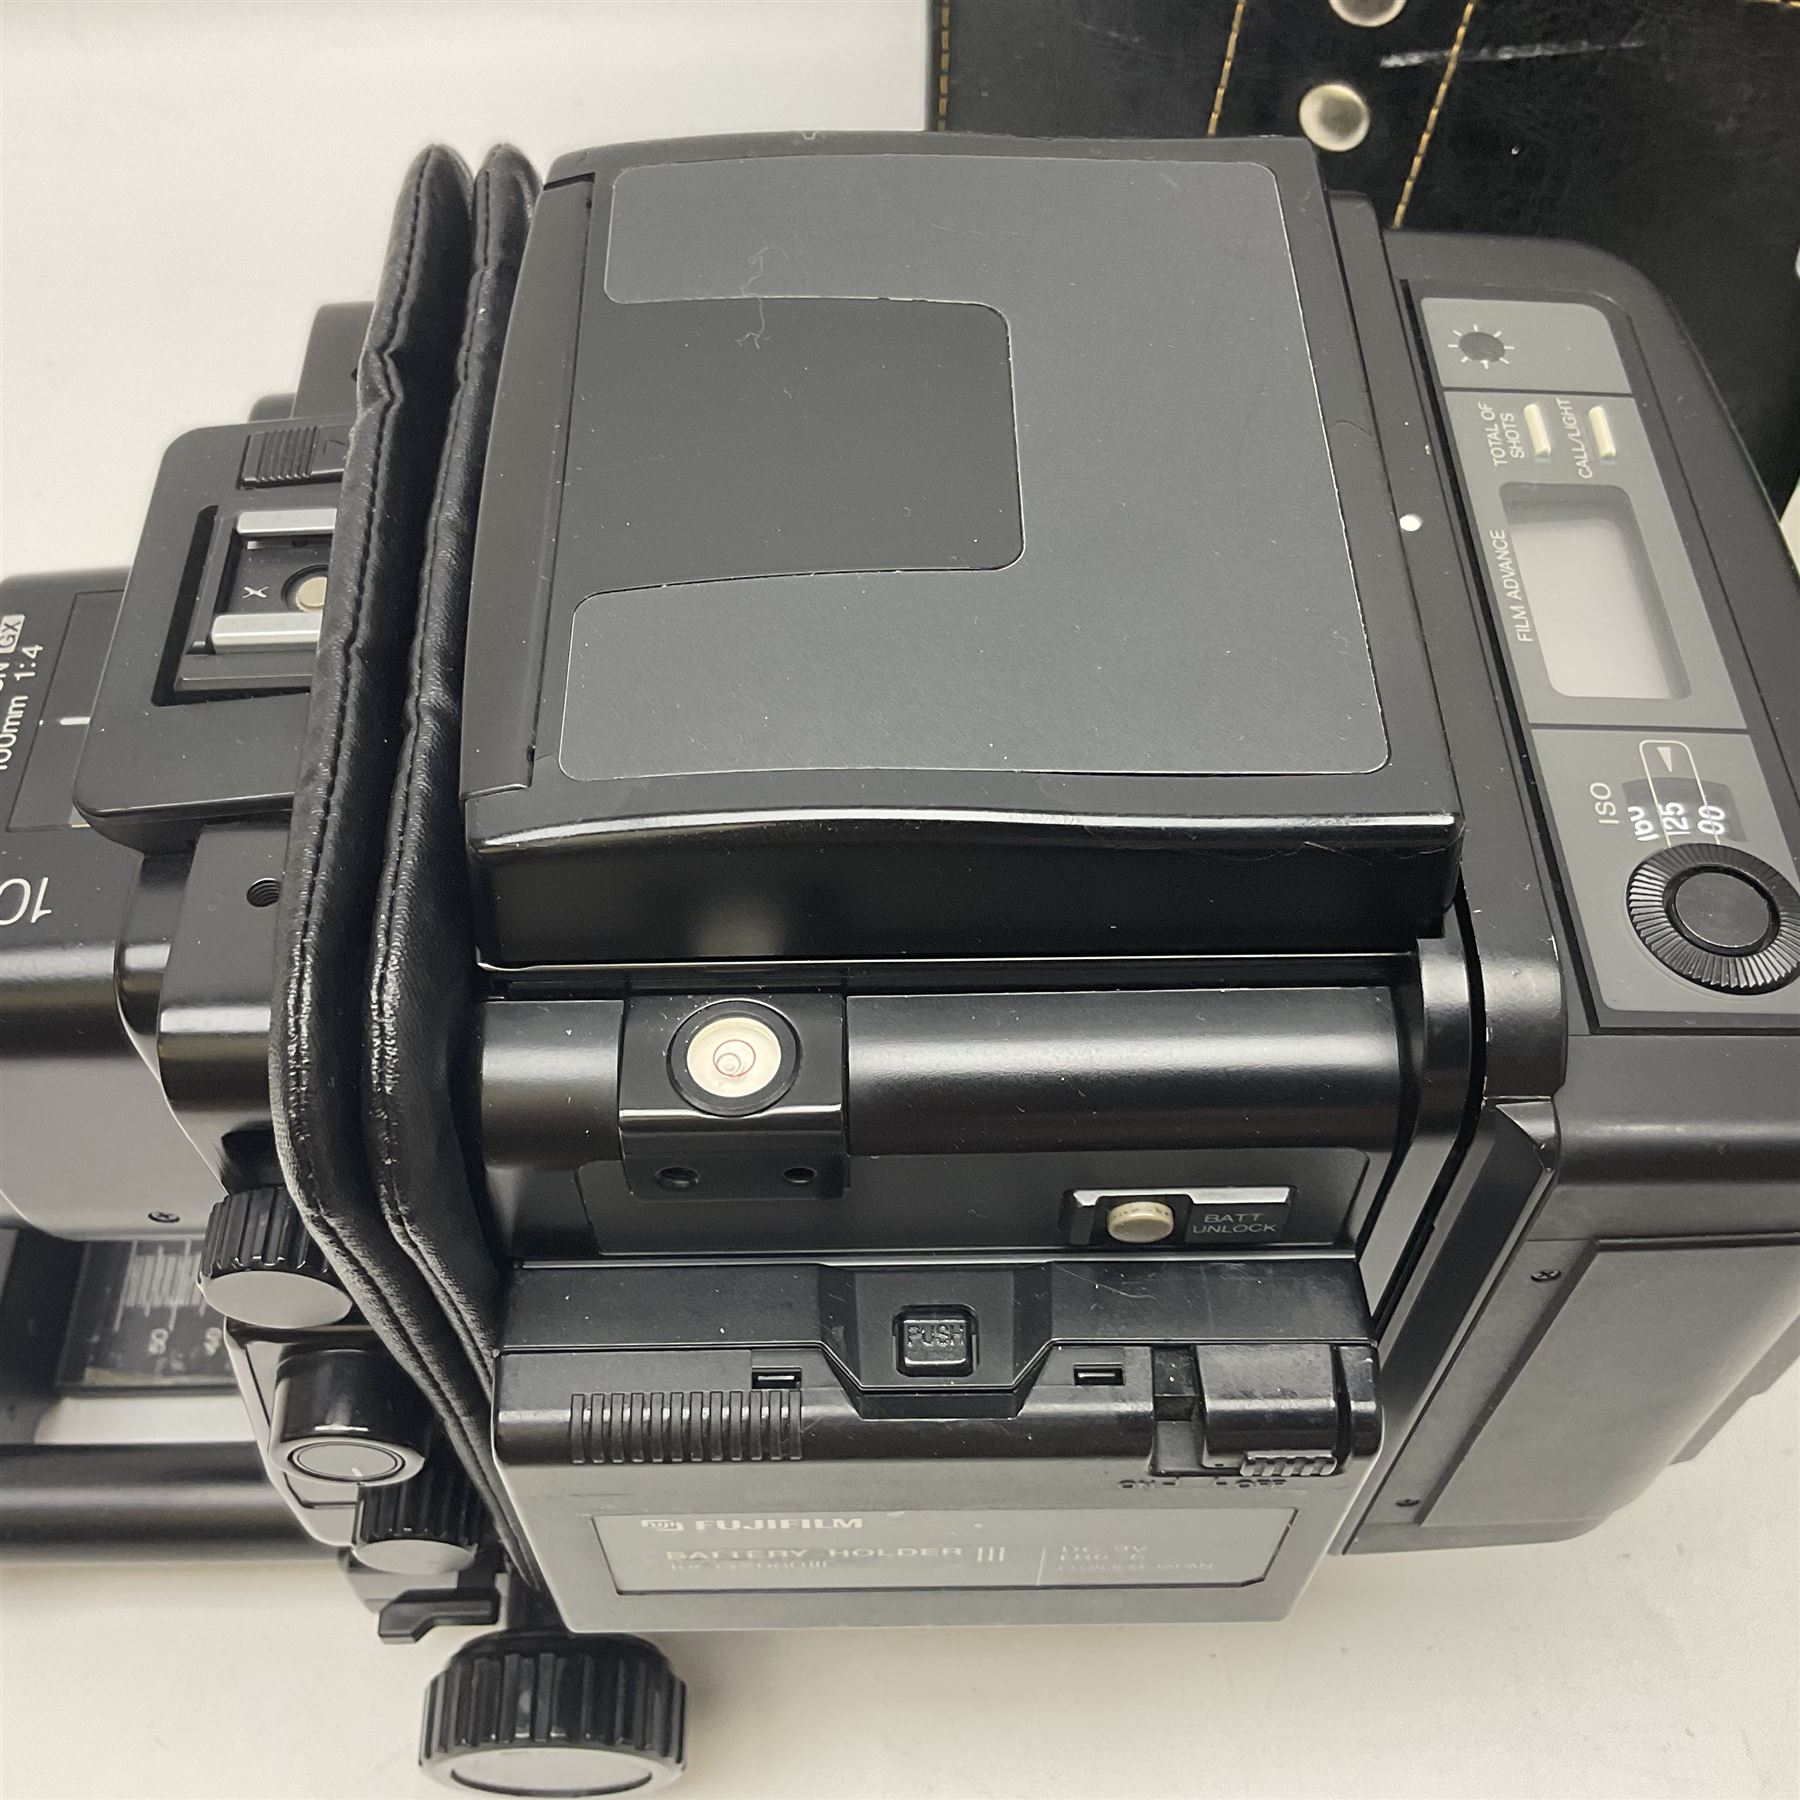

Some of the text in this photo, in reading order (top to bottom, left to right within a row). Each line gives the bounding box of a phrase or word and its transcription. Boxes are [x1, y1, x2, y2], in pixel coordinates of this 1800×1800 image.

[1478, 402, 1508, 467] TOTAL OF
[1502, 412, 1524, 460] SHOTS
[1555, 397, 1593, 479] CALL/LIGHT
[243, 586, 269, 599] X
[1490, 529, 1533, 642] FILM ADVANCE
[14, 644, 43, 681] 1:4
[1589, 782, 1620, 825] ISO
[1657, 802, 1691, 835] 125
[1192, 1224, 1277, 1234] UNLOCK
[1204, 1213, 1264, 1223] BATT
[907, 1325, 964, 1347] PUSH
[695, 1517, 864, 1531] FUJIFILM
[665, 1548, 808, 1560] BATTERY
[829, 1546, 963, 1558] HOLDER
